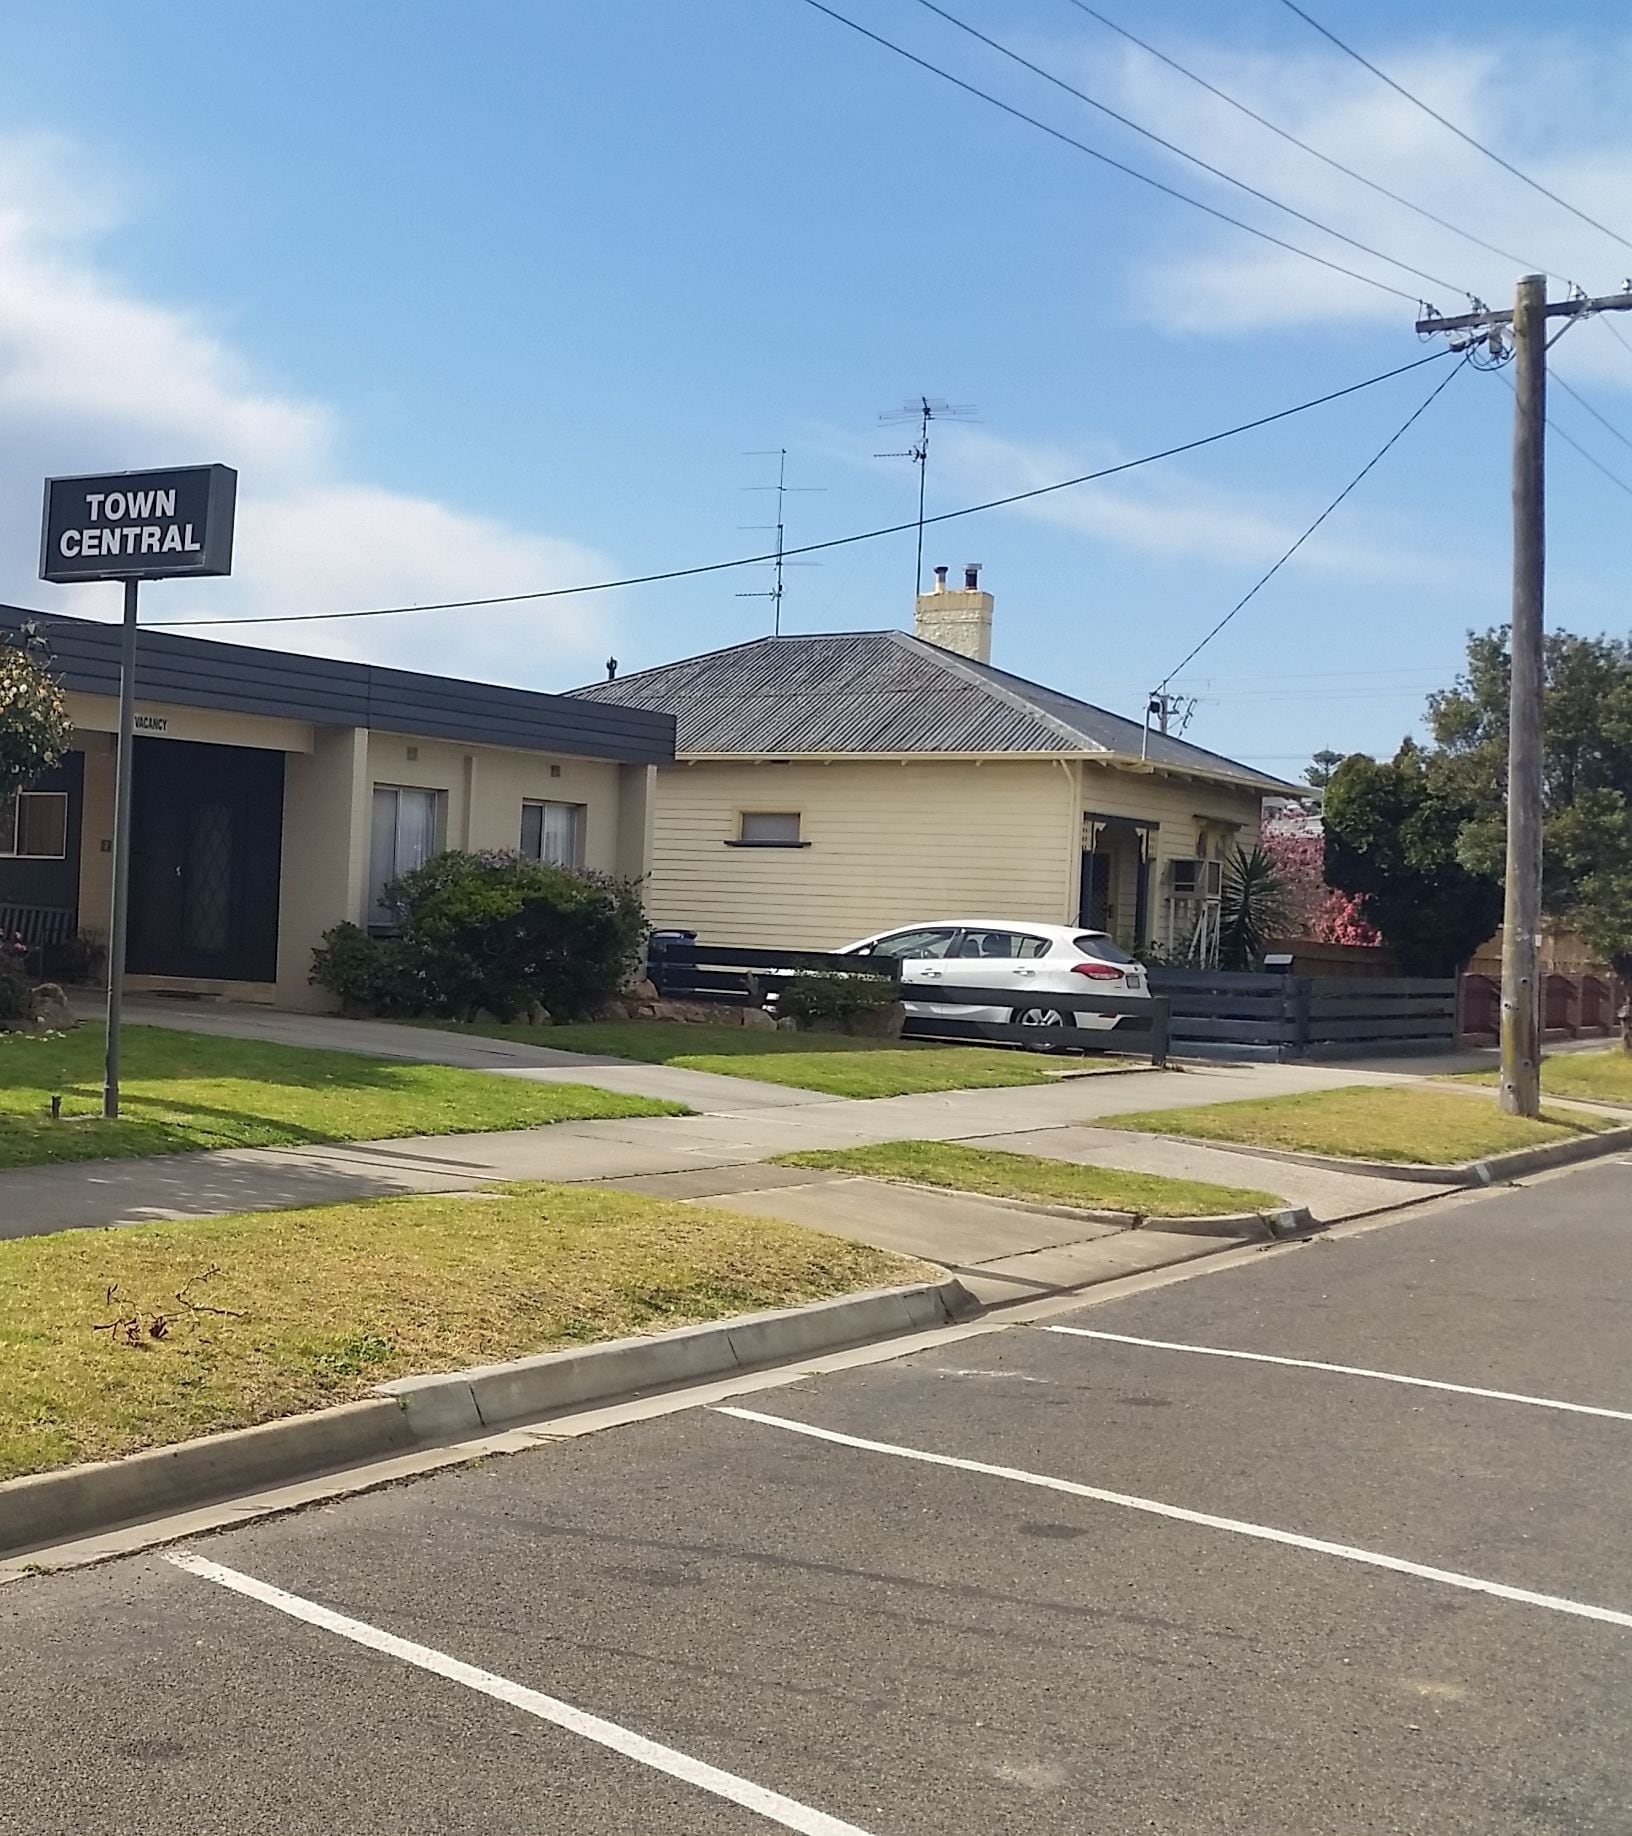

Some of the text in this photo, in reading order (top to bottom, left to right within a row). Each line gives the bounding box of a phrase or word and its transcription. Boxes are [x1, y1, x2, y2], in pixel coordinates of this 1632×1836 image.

[85, 488, 176, 521] TOWN
[60, 523, 201, 558] CENTRAL
[134, 715, 168, 731] VACANCY
